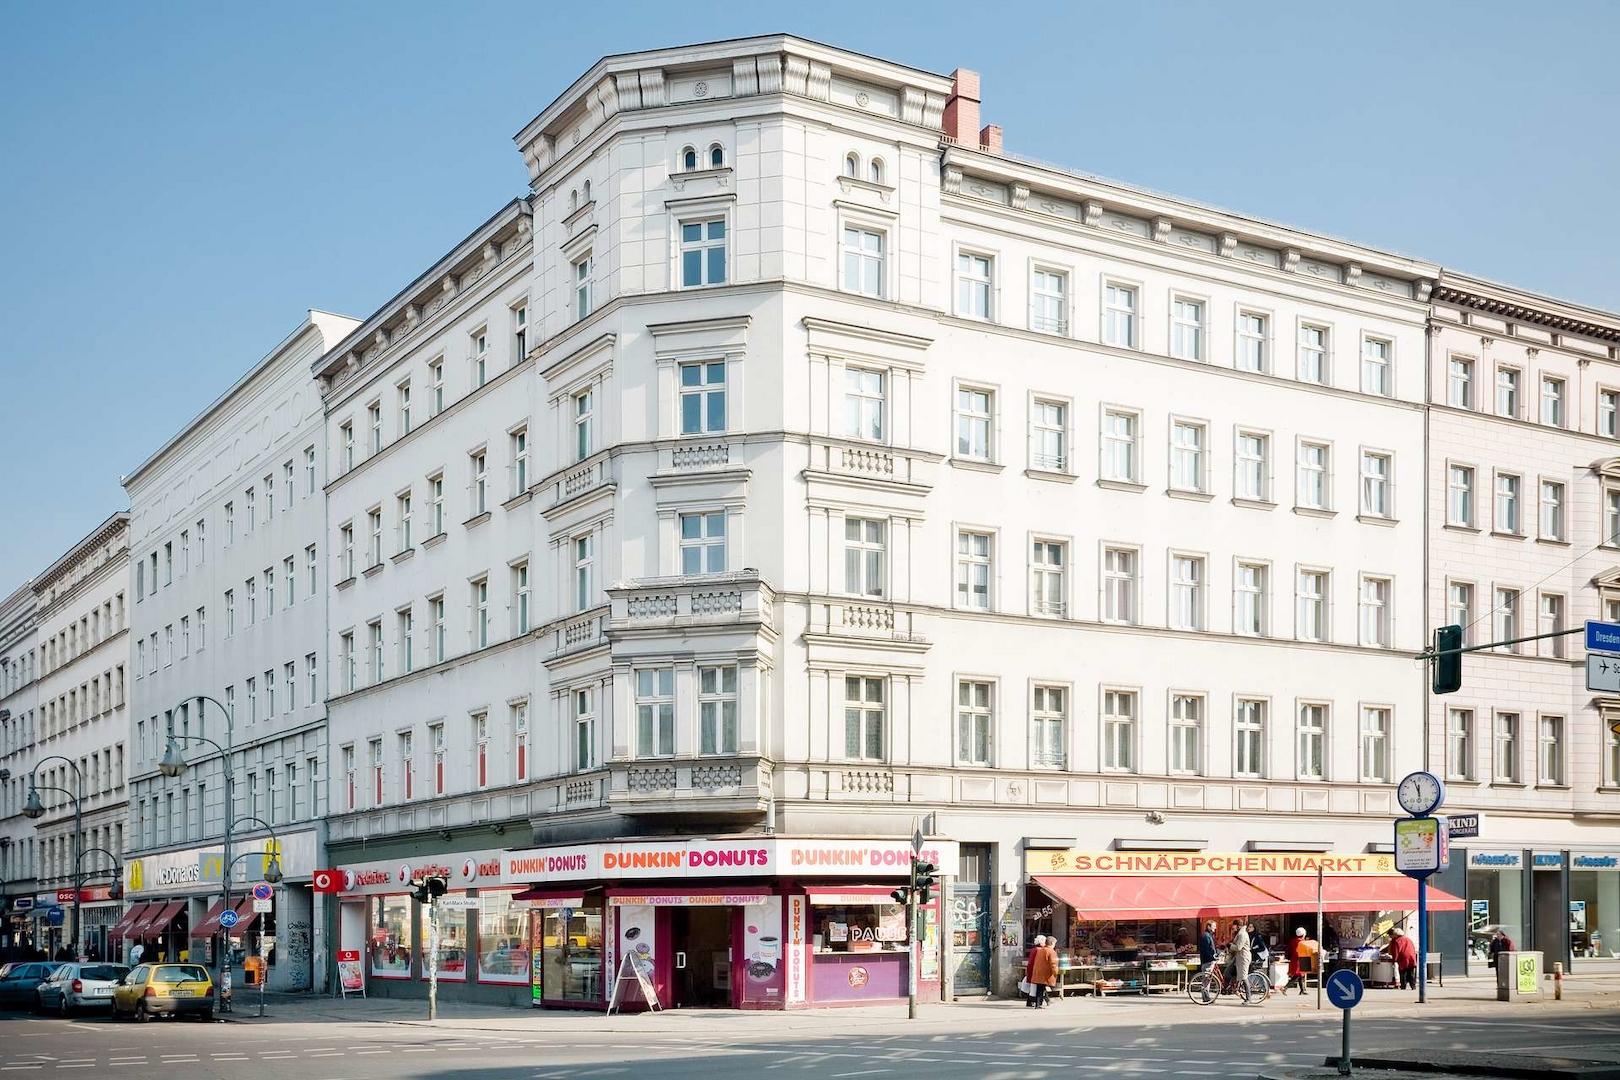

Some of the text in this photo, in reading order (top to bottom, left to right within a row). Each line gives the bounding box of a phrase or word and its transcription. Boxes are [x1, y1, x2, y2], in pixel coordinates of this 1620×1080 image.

[1595, 630, 1620, 644] Dresden
[1449, 817, 1477, 828] KIND
[510, 854, 587, 875] DUNKIN' DONUTS
[603, 849, 768, 869] DUNKIN' DONUTS
[791, 848, 869, 866] DUNKIN'
[1075, 854, 1366, 872] SCHNÄPPCHEN MARKT
[649, 896, 683, 904] DONUTS
[1042, 904, 1053, 917] 55
